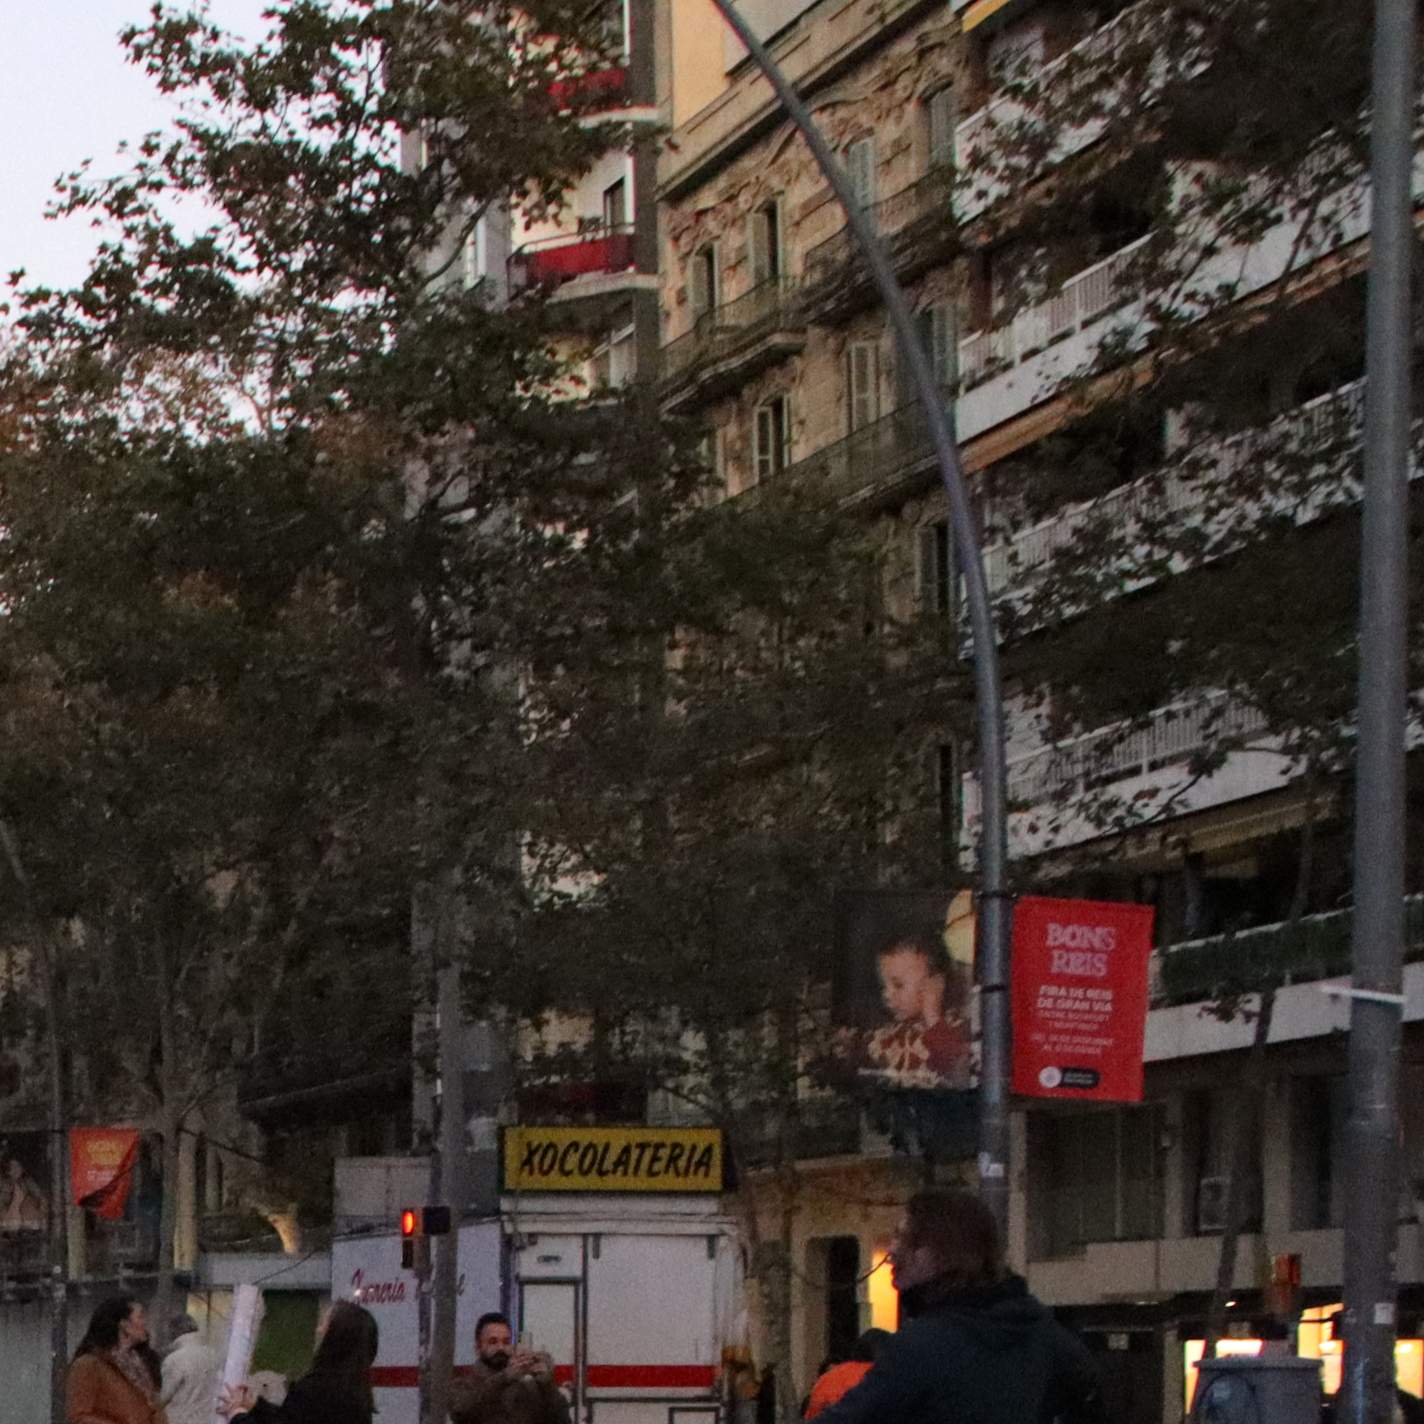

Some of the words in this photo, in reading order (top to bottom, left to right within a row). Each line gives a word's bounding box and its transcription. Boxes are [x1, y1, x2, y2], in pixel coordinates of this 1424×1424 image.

[1046, 922, 1117, 951] BONS
[1050, 949, 1108, 977] REIS
[519, 1141, 713, 1179] XOCOLATERIA
